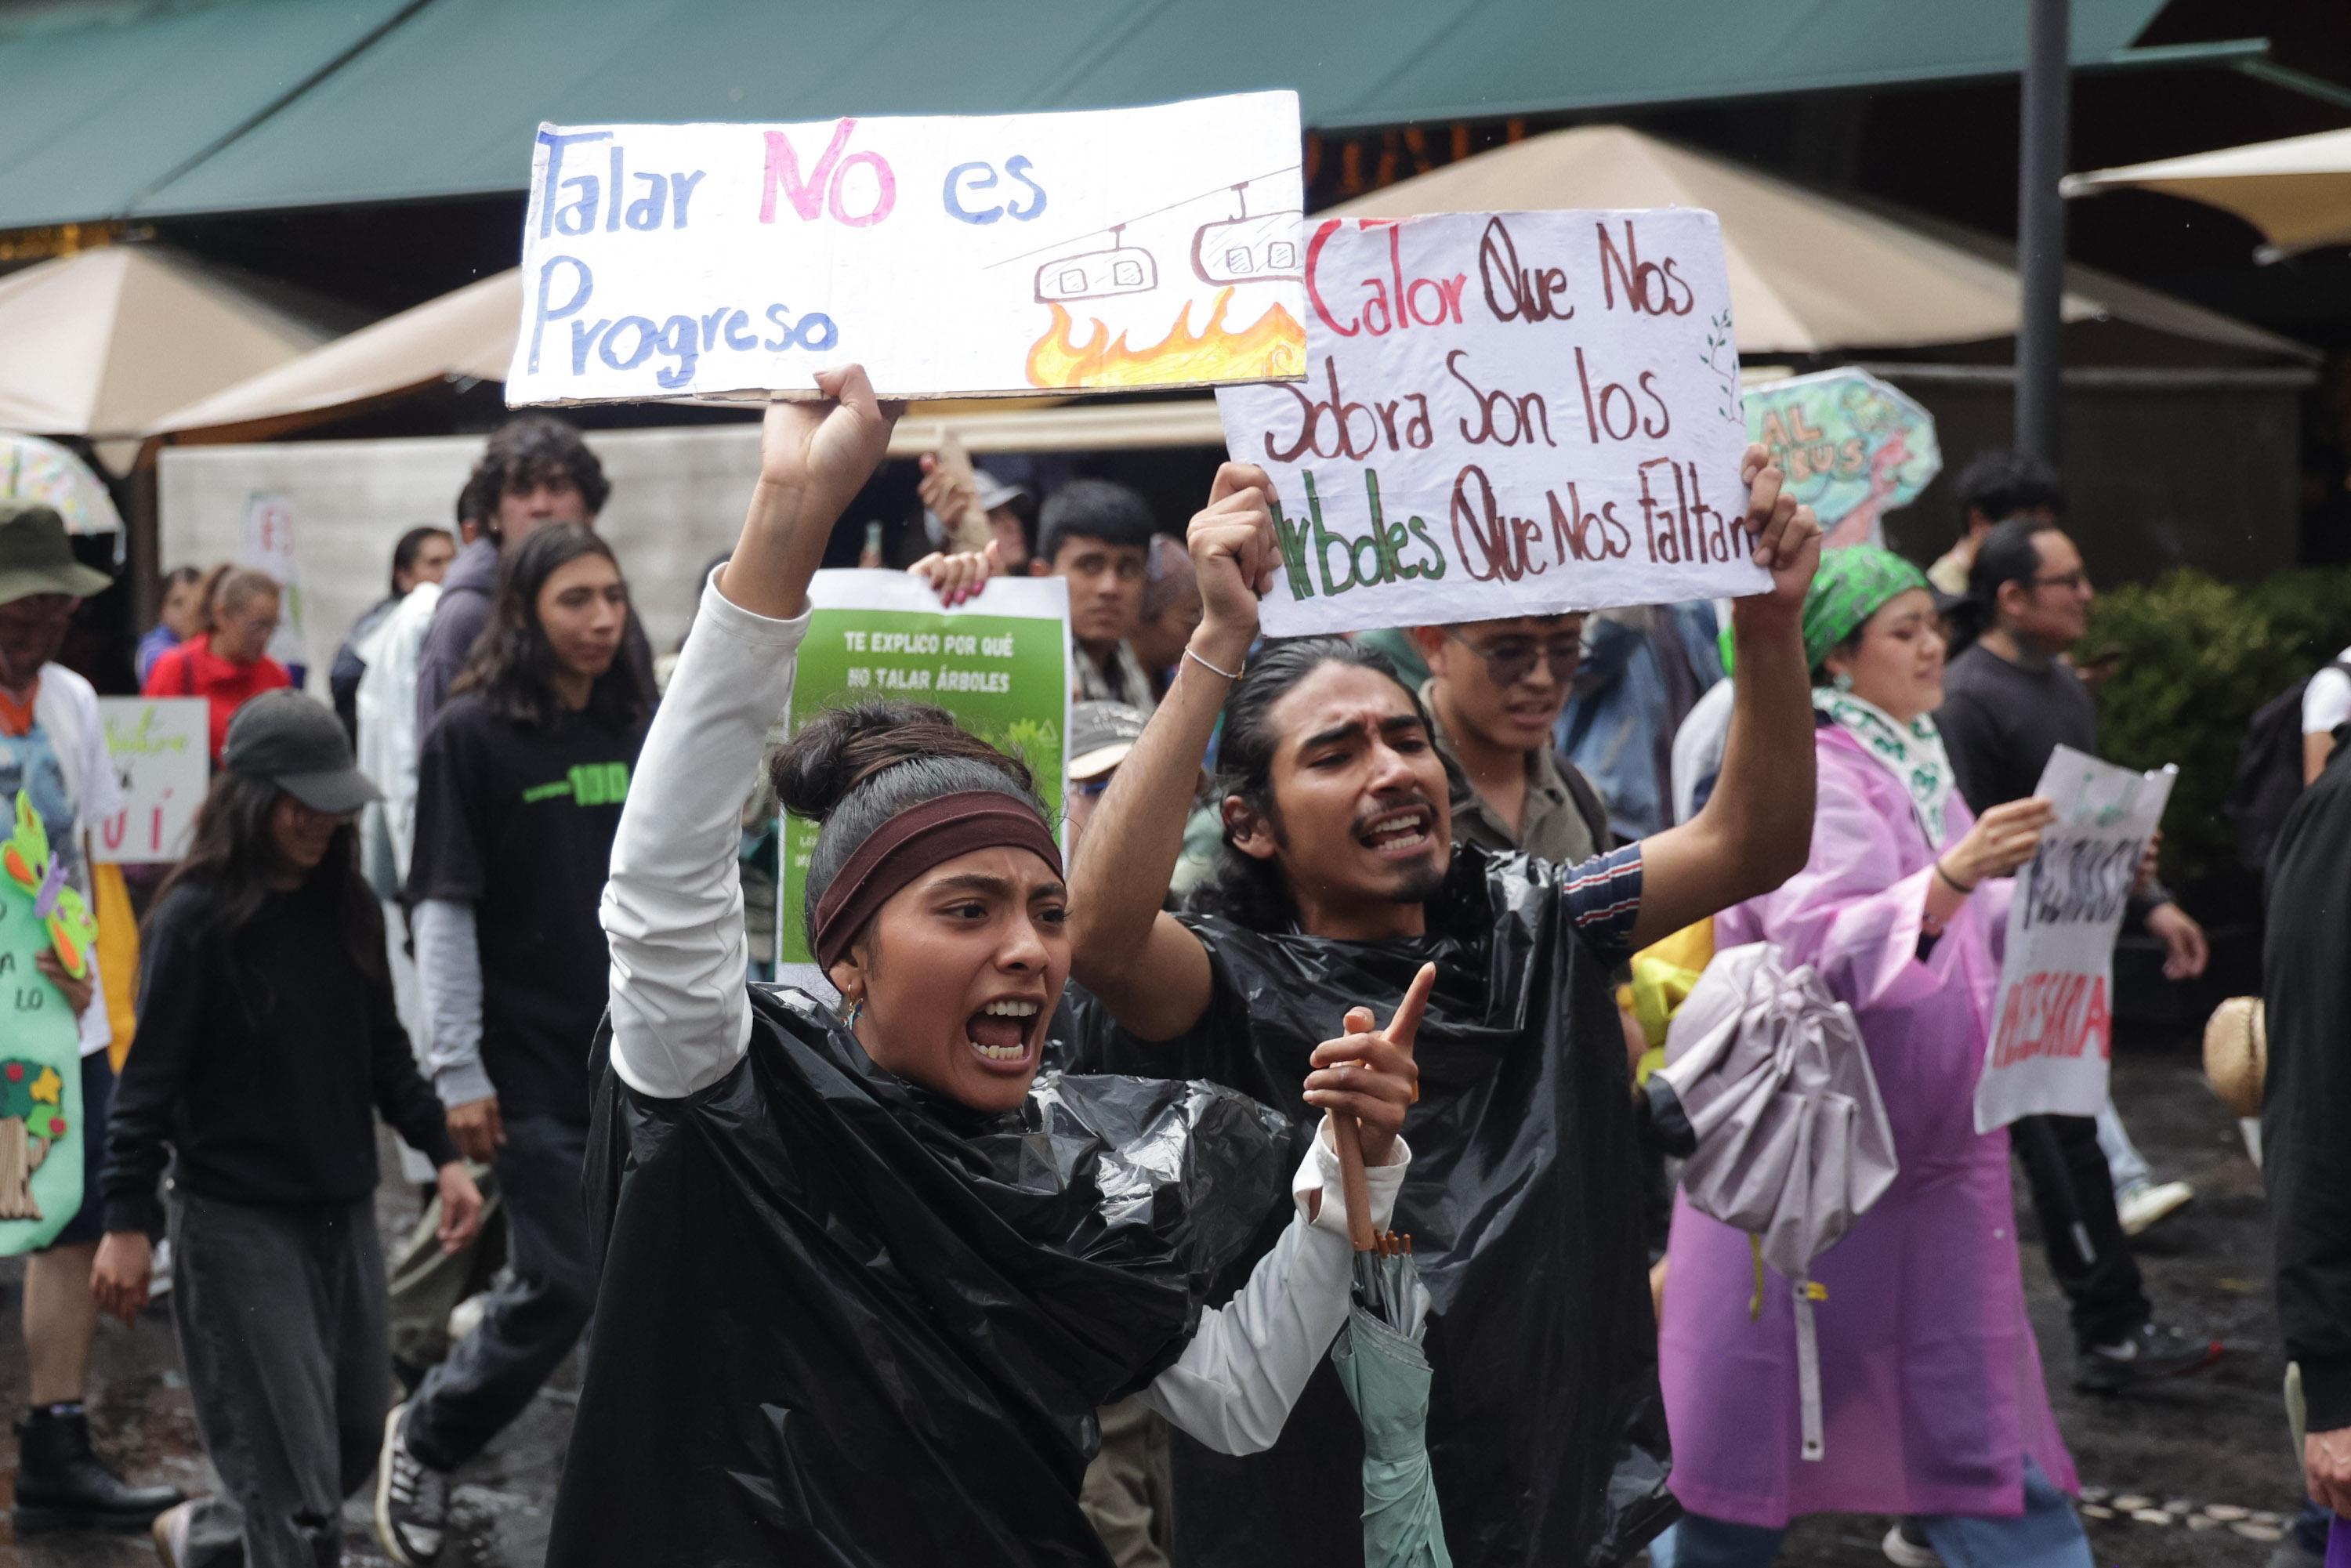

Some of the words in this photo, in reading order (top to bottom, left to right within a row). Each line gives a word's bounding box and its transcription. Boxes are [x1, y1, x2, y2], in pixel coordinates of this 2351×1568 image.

[537, 129, 707, 239] Talar
[943, 154, 1049, 225] es
[527, 255, 840, 389] Progreso
[1305, 219, 1467, 337] Calor
[1479, 216, 1574, 324] Que
[1596, 221, 1694, 316] Nos
[1446, 349, 1557, 447] Son
[1574, 346, 1670, 444] los
[1450, 464, 1547, 585] Que
[1545, 481, 1632, 567] Nos
[844, 631, 867, 653] TE
[871, 632, 940, 655] EXPLICO
[944, 634, 976, 656] POR
[981, 632, 1014, 657] QUÉ
[848, 667, 871, 689] NO
[875, 668, 932, 690] TALAR
[936, 664, 1011, 693] ÁRBOLES
